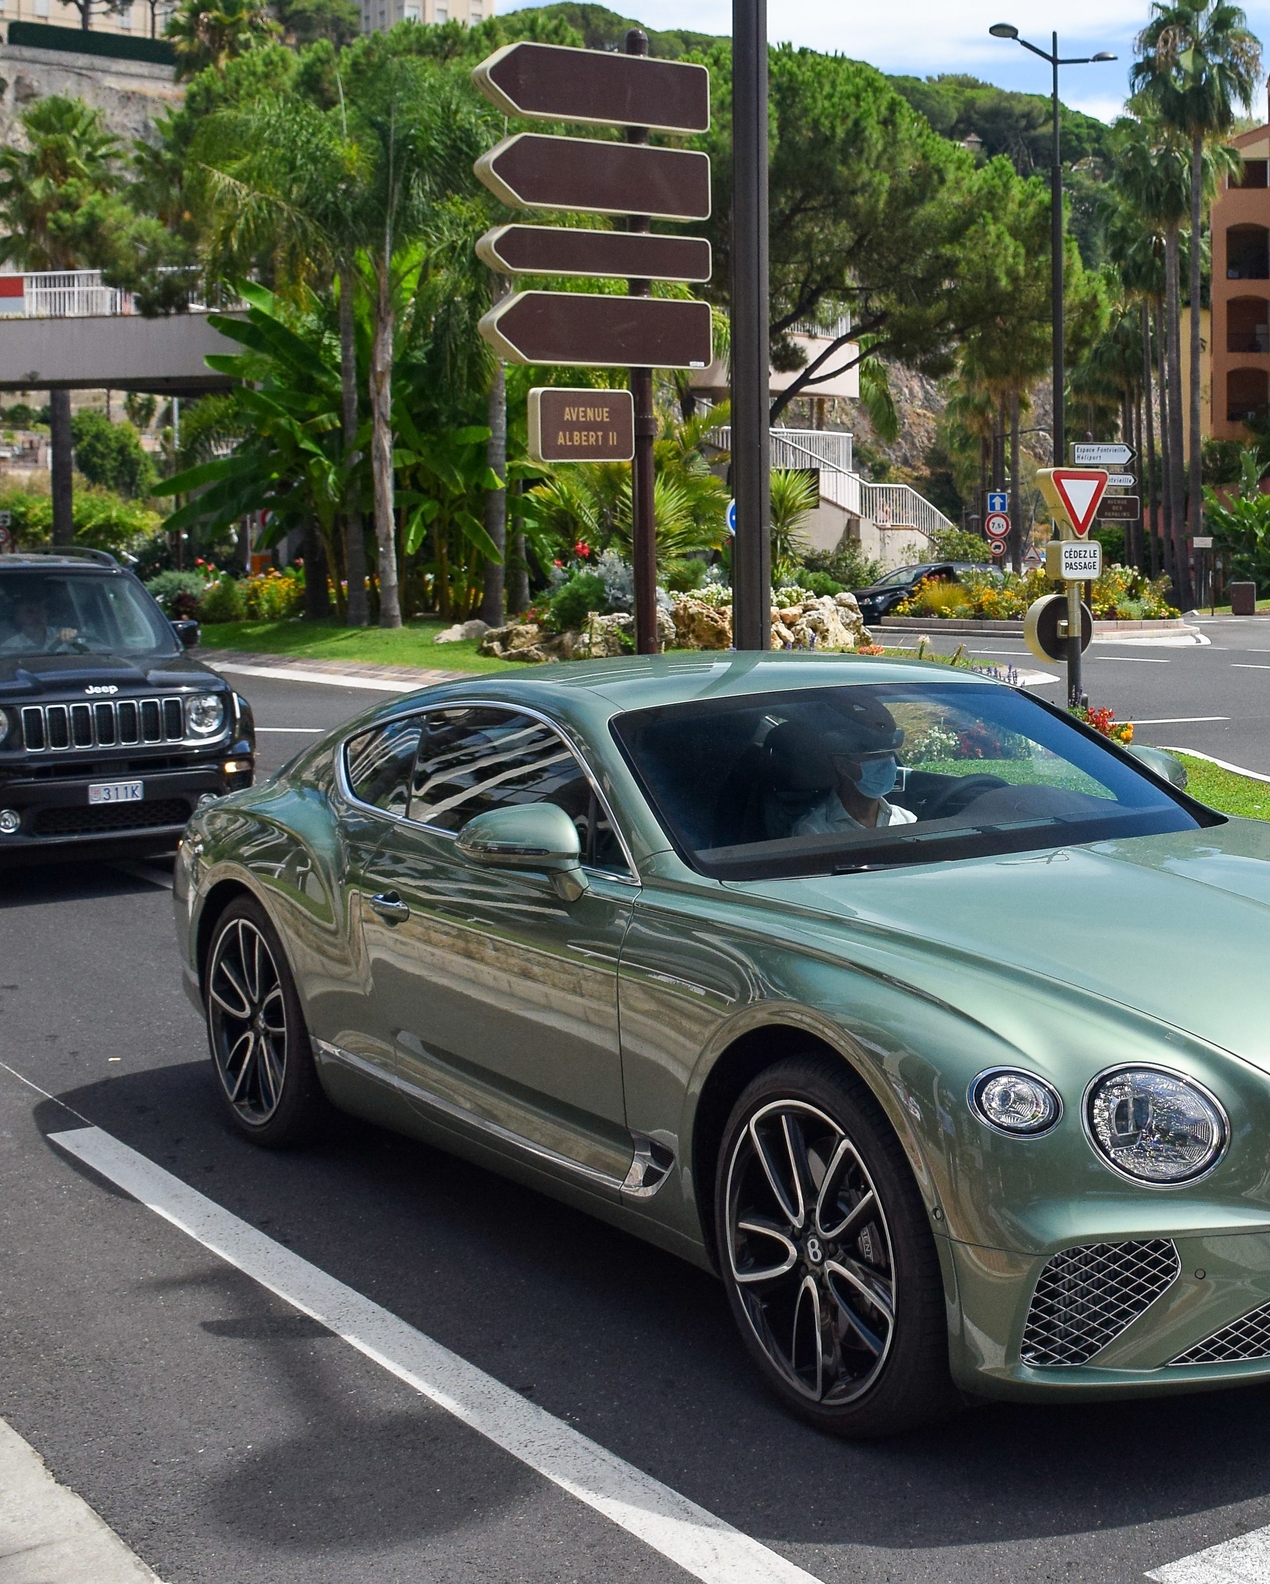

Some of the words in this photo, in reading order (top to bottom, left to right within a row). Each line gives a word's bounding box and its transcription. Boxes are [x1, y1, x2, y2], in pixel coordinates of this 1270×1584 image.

[564, 407, 610, 421] AVENUE
[557, 431, 603, 445] ALBERT
[609, 431, 617, 445] II
[1076, 446, 1095, 454] Espace
[1064, 548, 1088, 559] CÉDEZ
[1089, 549, 1098, 558] LE
[1065, 561, 1097, 571] PASSAGE
[85, 685, 118, 695] Jeep
[103, 785, 140, 801] 311K
